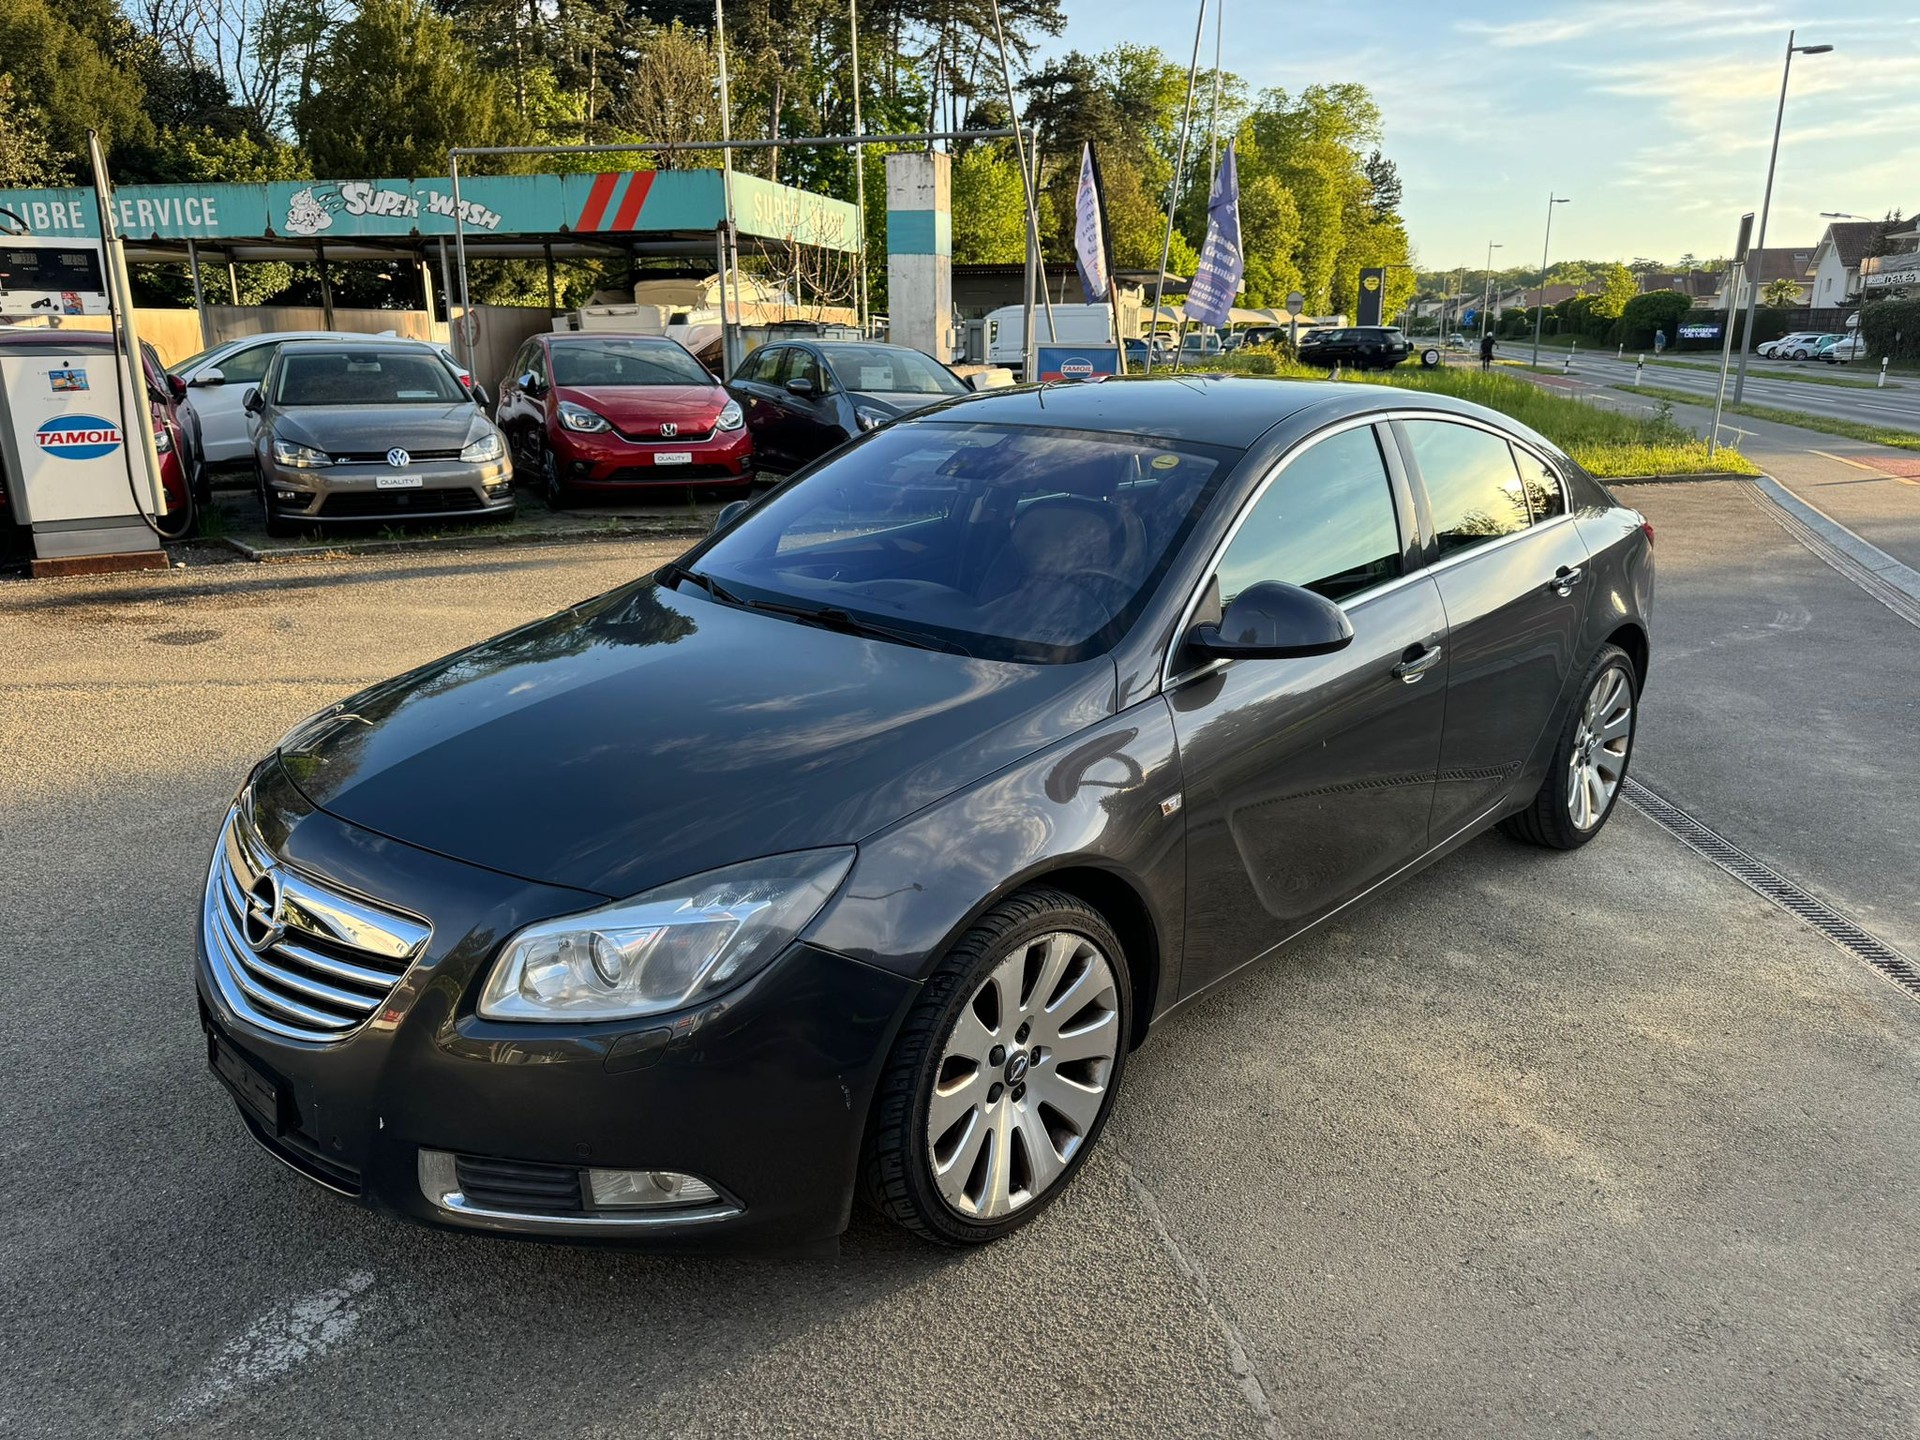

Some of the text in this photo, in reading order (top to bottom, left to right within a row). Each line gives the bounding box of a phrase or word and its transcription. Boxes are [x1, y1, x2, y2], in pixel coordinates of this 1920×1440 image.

[6, 197, 219, 230] LIBRE SERVICE
[341, 183, 502, 230] SUPER WASH
[36, 430, 122, 445] TAMOIL
